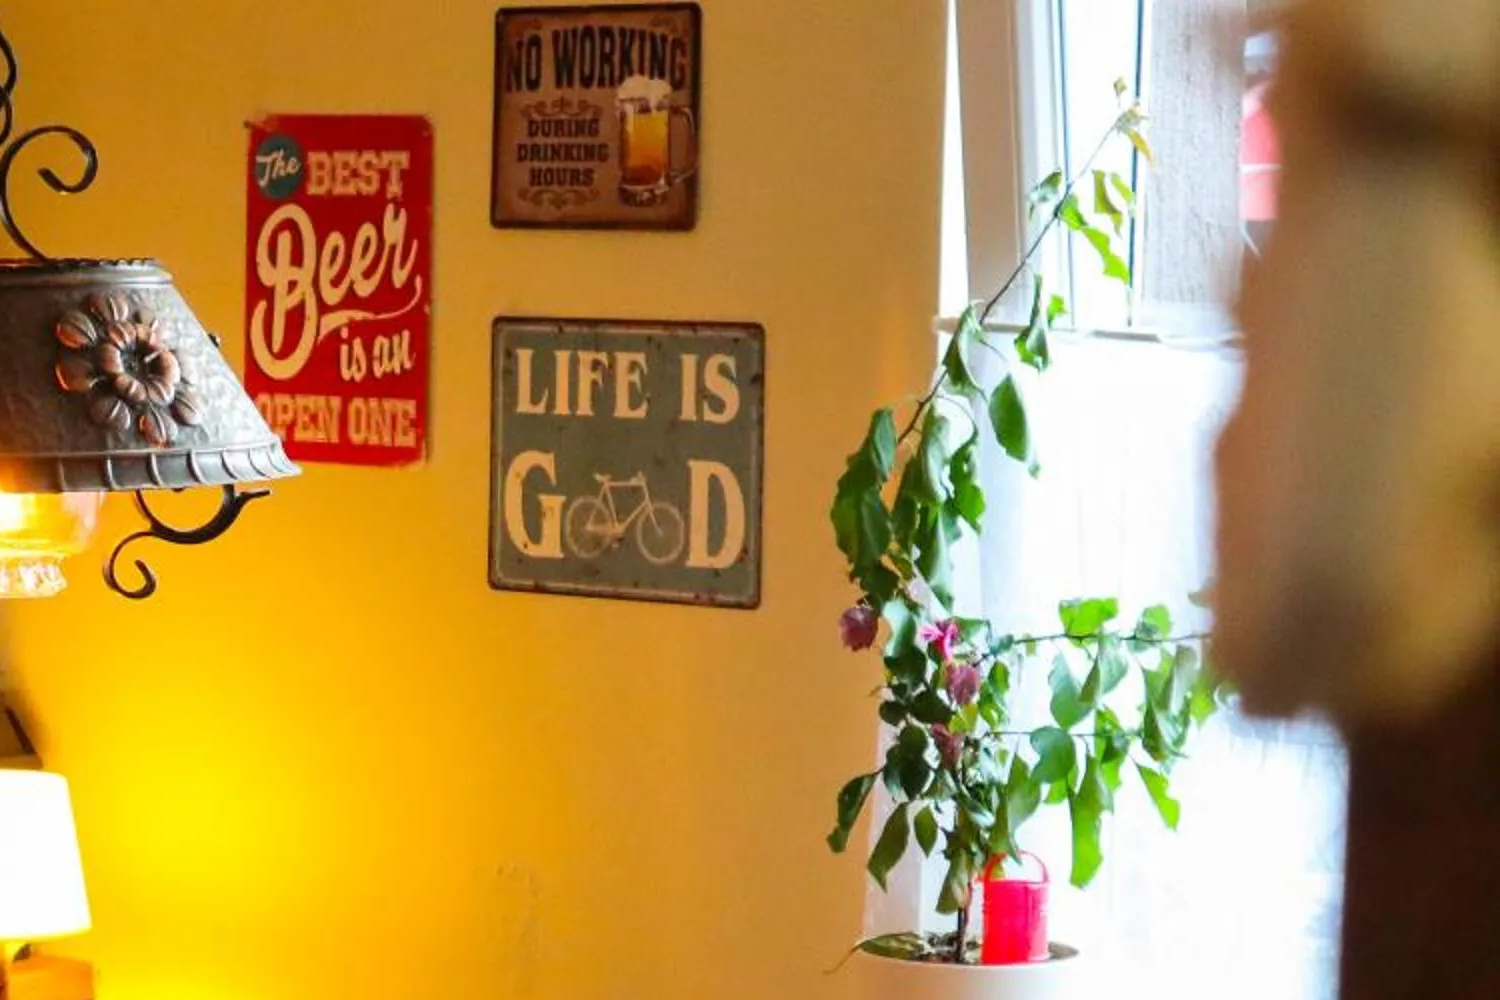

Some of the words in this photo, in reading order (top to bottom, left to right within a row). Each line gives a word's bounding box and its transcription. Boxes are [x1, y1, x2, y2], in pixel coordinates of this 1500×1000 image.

[506, 34, 542, 92] NO
[552, 26, 687, 91] WORKING
[516, 143, 609, 162] DRINKING
[528, 118, 599, 137] DURING
[256, 149, 300, 187] The
[307, 151, 410, 198] BEST
[529, 167, 595, 187] HOURS
[251, 203, 418, 380] Beer
[340, 326, 366, 382] is
[373, 329, 417, 380] an
[516, 348, 648, 419] LIFE
[679, 353, 740, 424] IS
[348, 397, 417, 447] ONE
